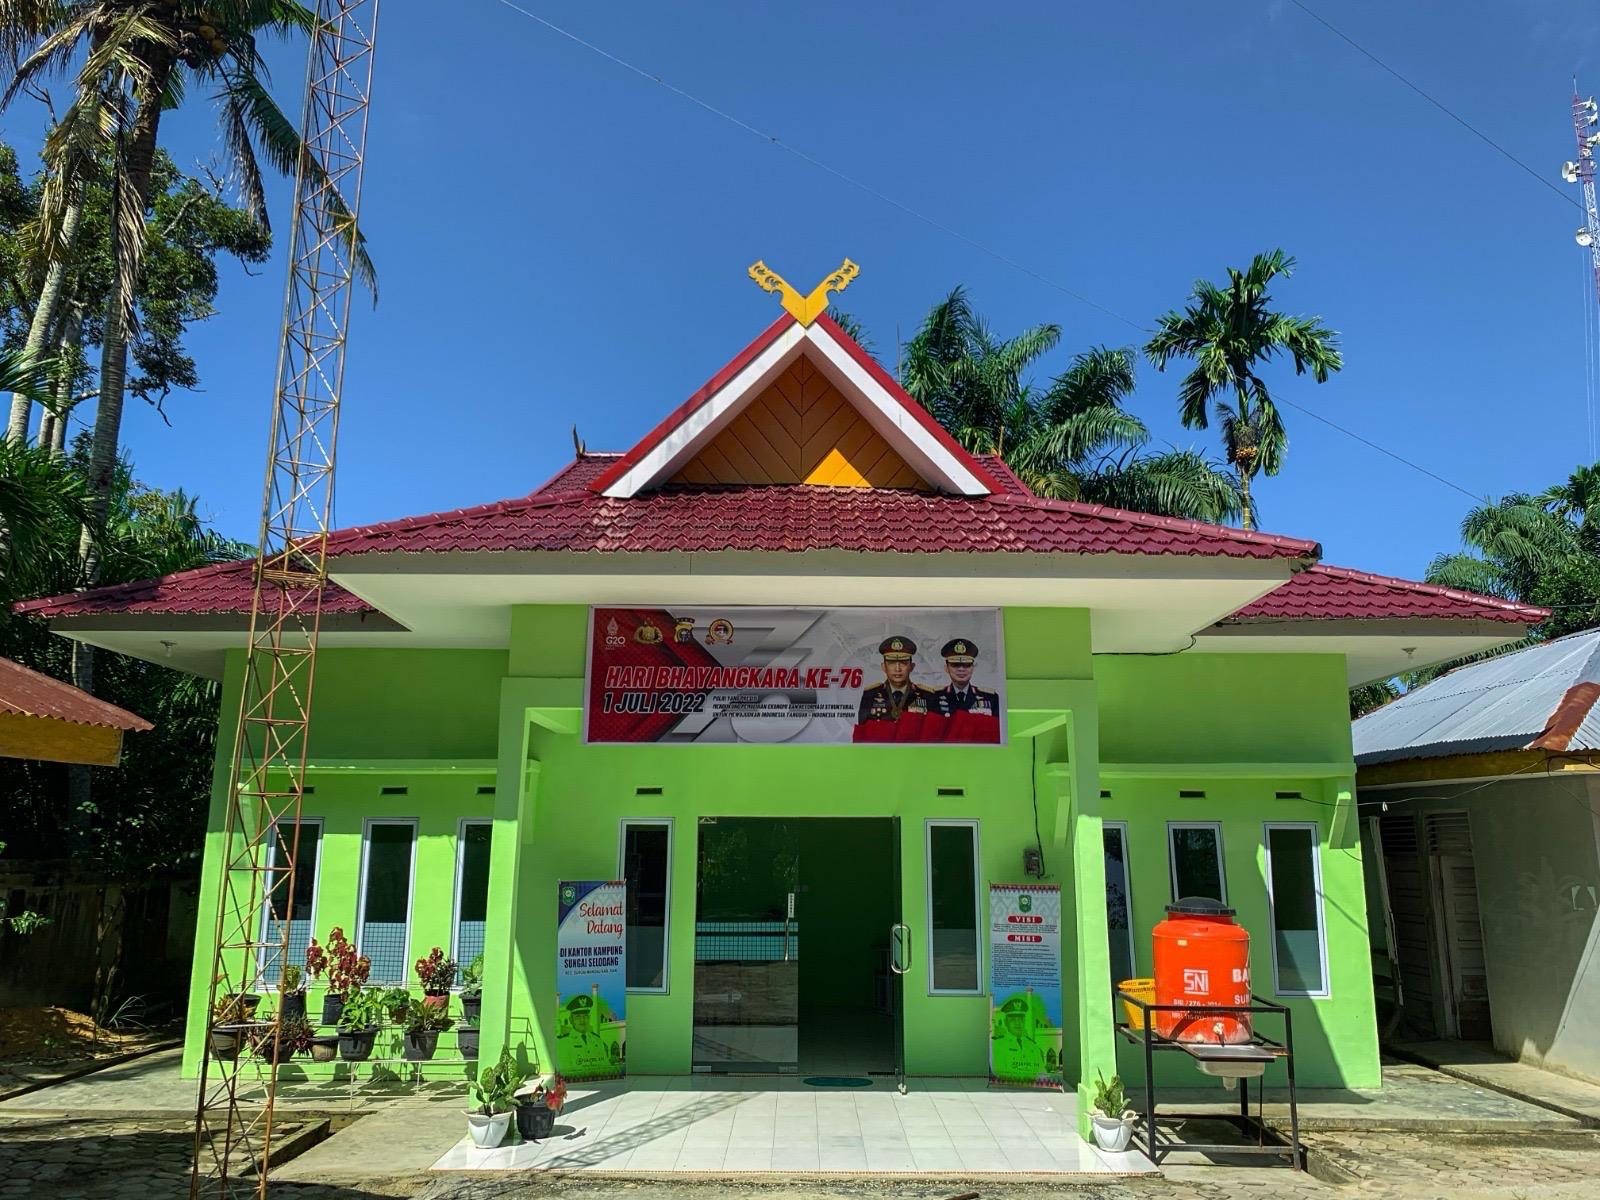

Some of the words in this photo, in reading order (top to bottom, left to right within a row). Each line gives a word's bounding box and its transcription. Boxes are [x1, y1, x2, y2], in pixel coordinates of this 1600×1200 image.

[605, 666, 654, 688] HARI
[655, 666, 800, 689] BHAYANGKARA
[804, 666, 864, 689] KE-76
[603, 692, 613, 714] 1
[614, 692, 658, 714] JULI
[659, 692, 706, 714] 2022
[580, 901, 624, 918] Selamat
[587, 919, 624, 939] Datang
[560, 948, 567, 957] DI
[568, 947, 592, 957] KANTOR
[593, 946, 623, 956] KAMPUNG
[564, 958, 587, 968] SUNGAI
[588, 956, 619, 968] SELODANG
[1184, 971, 1209, 993] SNI
